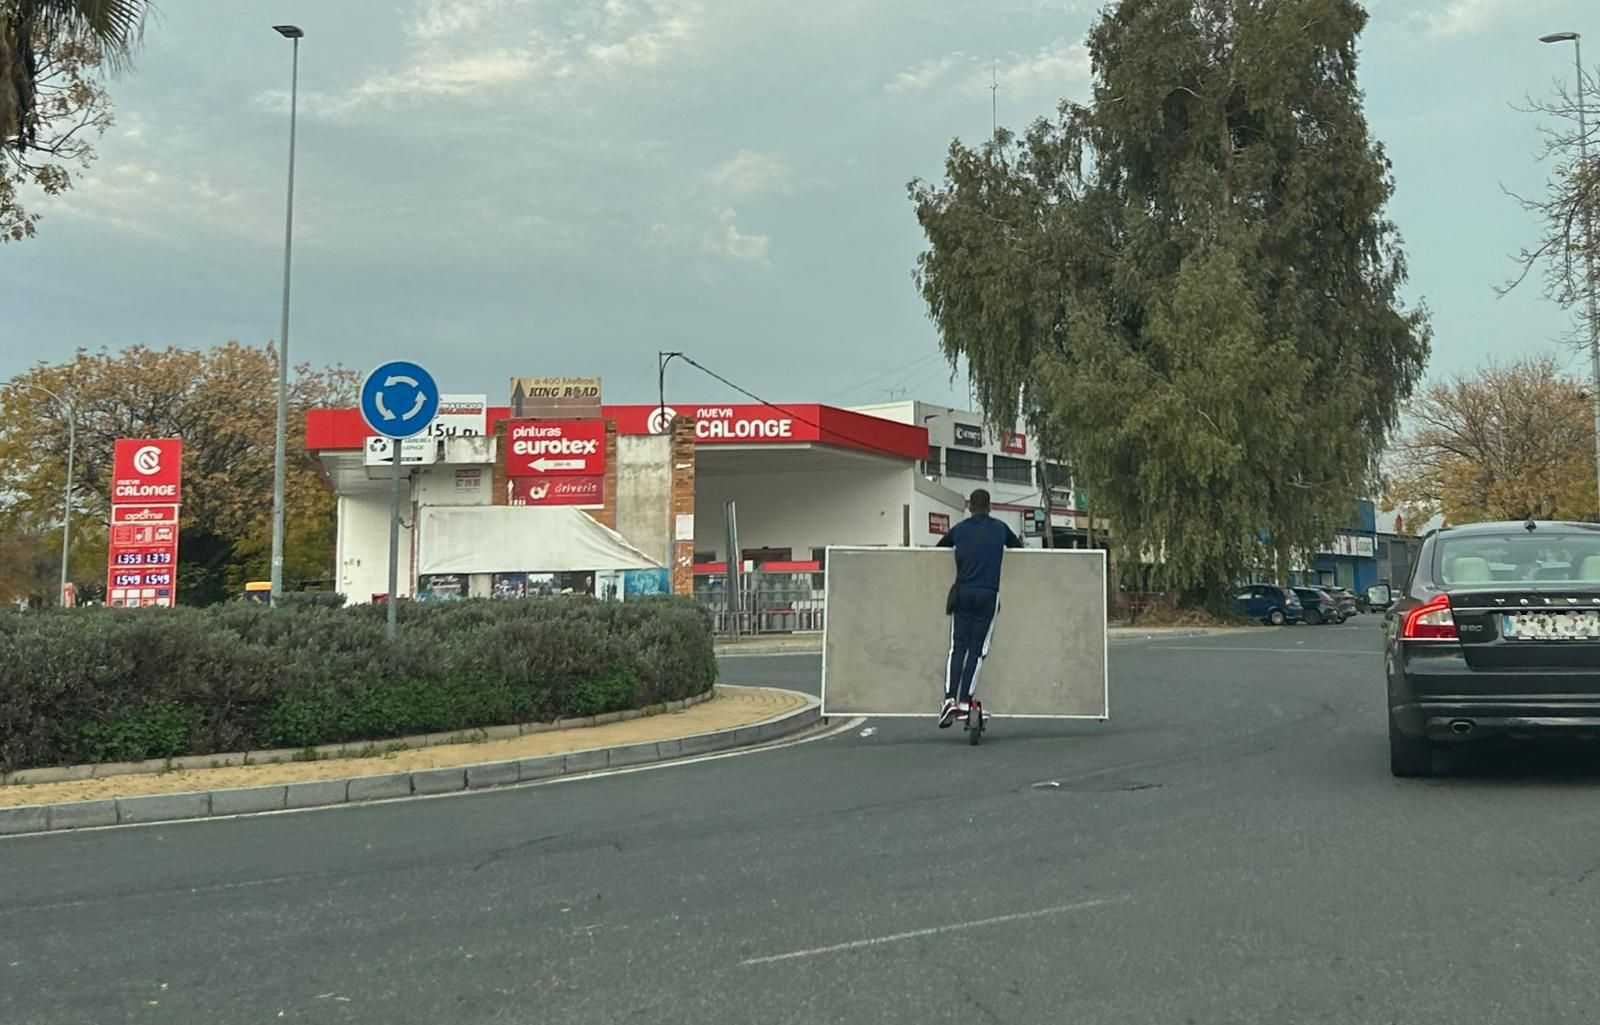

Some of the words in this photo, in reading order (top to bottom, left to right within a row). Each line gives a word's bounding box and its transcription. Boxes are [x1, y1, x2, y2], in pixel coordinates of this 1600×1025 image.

[529, 387, 560, 397] KING
[697, 408, 733, 418] NUEVA
[513, 426, 562, 440] pinturas
[695, 419, 792, 438] CALONGE
[513, 438, 597, 455] eurotex
[116, 485, 176, 497] CALONGE
